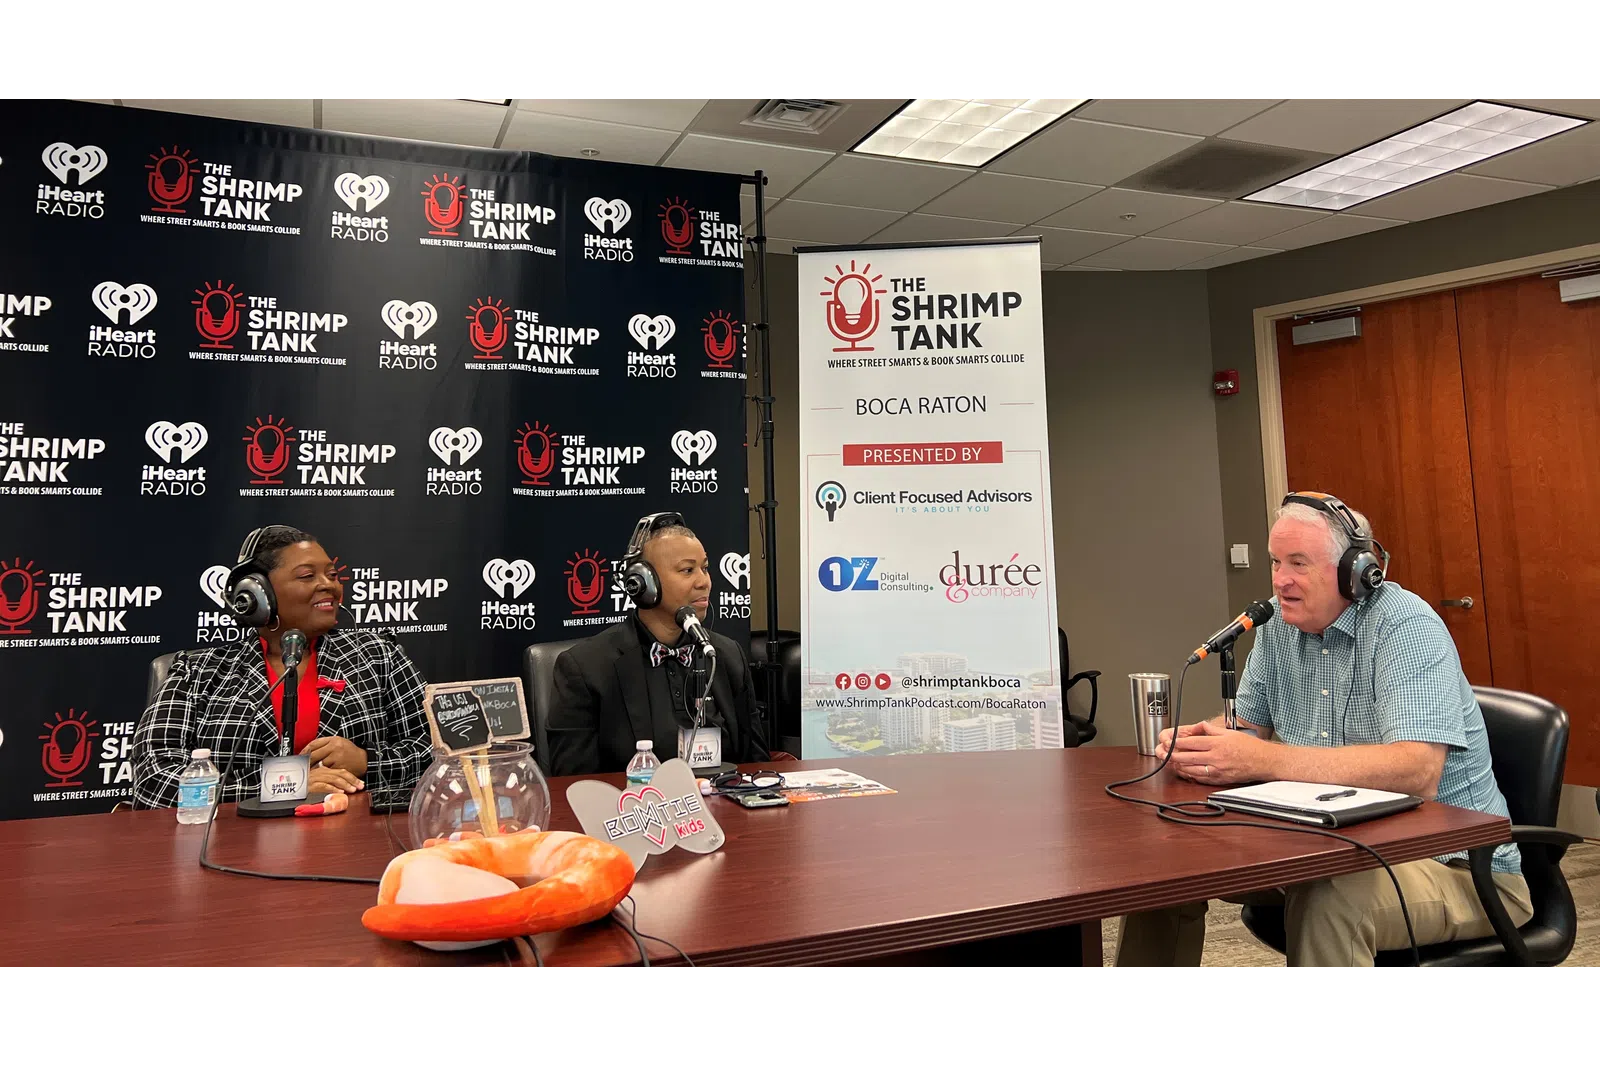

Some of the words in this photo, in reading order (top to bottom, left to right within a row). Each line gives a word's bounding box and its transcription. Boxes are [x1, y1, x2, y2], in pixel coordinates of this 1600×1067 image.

[204, 163, 232, 176] THE
[38, 184, 104, 204] iHeart
[202, 176, 302, 202] SHRIMP
[470, 189, 494, 200] THE
[37, 201, 104, 218] RADIO
[200, 197, 271, 221] TANK
[470, 200, 556, 224] SHRIMP
[699, 211, 719, 221] THE
[141, 215, 165, 223] WHERE
[167, 217, 191, 225] STREET
[193, 219, 219, 228] SMARTS
[247, 224, 273, 232] SMARTS
[274, 226, 300, 234] COLLIDE
[332, 211, 388, 229] iHeart
[332, 226, 388, 242] RADIO
[469, 220, 530, 240] TANK
[585, 234, 632, 249] iHeart
[534, 246, 556, 256] COLLIDE
[585, 248, 633, 262] RADIO
[890, 278, 925, 292] THE
[249, 296, 276, 308] THE
[892, 292, 1022, 321] SHRIMP
[248, 310, 348, 332] SHRIMP
[515, 310, 538, 322] THE
[90, 325, 156, 343] iHeart
[515, 322, 599, 345] SHRIMP
[892, 323, 982, 350] TANK
[19, 344, 48, 352] COLLIDE
[247, 331, 317, 352] TANK
[380, 340, 436, 356] iHeart
[88, 342, 155, 358] RADIO
[514, 342, 573, 364] TANK
[380, 356, 437, 370] RADIO
[628, 351, 675, 365] iHeart
[828, 359, 856, 368] WHERE
[858, 359, 886, 367] STREET
[889, 358, 921, 366] SMARTS
[923, 357, 929, 365] &
[932, 356, 954, 365] BOOK
[956, 355, 988, 364] SMARTS
[991, 354, 1024, 363] COLLIDE
[628, 366, 676, 378] RADIO
[857, 398, 912, 415] BOCA
[919, 396, 986, 414] RATON
[299, 430, 326, 441] THE
[562, 436, 585, 445] THE
[298, 443, 396, 463] SHRIMP
[562, 447, 645, 465] SHRIMP
[864, 448, 956, 462] PRESENTED
[962, 448, 981, 460] BY
[142, 465, 206, 480] iHeart
[297, 465, 365, 484] TANK
[428, 468, 481, 481] iHeart
[561, 467, 620, 485] TANK
[671, 468, 717, 480] iHeart
[141, 482, 205, 495] RADIO
[427, 482, 482, 495] RADIO
[671, 481, 718, 493] RADIO
[854, 492, 895, 504] Client
[900, 490, 962, 503] Focused
[967, 490, 1032, 502] Advisors
[352, 568, 379, 579] THE
[940, 550, 1041, 586] durée
[50, 573, 81, 585] THE
[881, 572, 908, 582] Digital
[352, 579, 448, 601] SHRIMP
[946, 574, 969, 603] &
[972, 587, 1038, 599] company
[48, 586, 162, 609] SHRIMP
[720, 592, 750, 605] iHea
[351, 602, 418, 623] TANK
[482, 601, 534, 616] iHeart
[720, 606, 750, 618] RAD
[47, 611, 126, 633] TANK
[397, 625, 421, 633] SMARTS
[482, 616, 535, 630] RADIO
[902, 675, 1020, 690] @shrimptankboca
[816, 697, 1046, 709] www.ShrimpTankPodcast.com/BocaRaton
[103, 722, 134, 735] THE
[34, 793, 60, 801] WHERE
[62, 791, 88, 800] STREET
[90, 788, 119, 798] SMARTS
[604, 793, 701, 840] BOWTIE
[674, 816, 705, 839] kids
